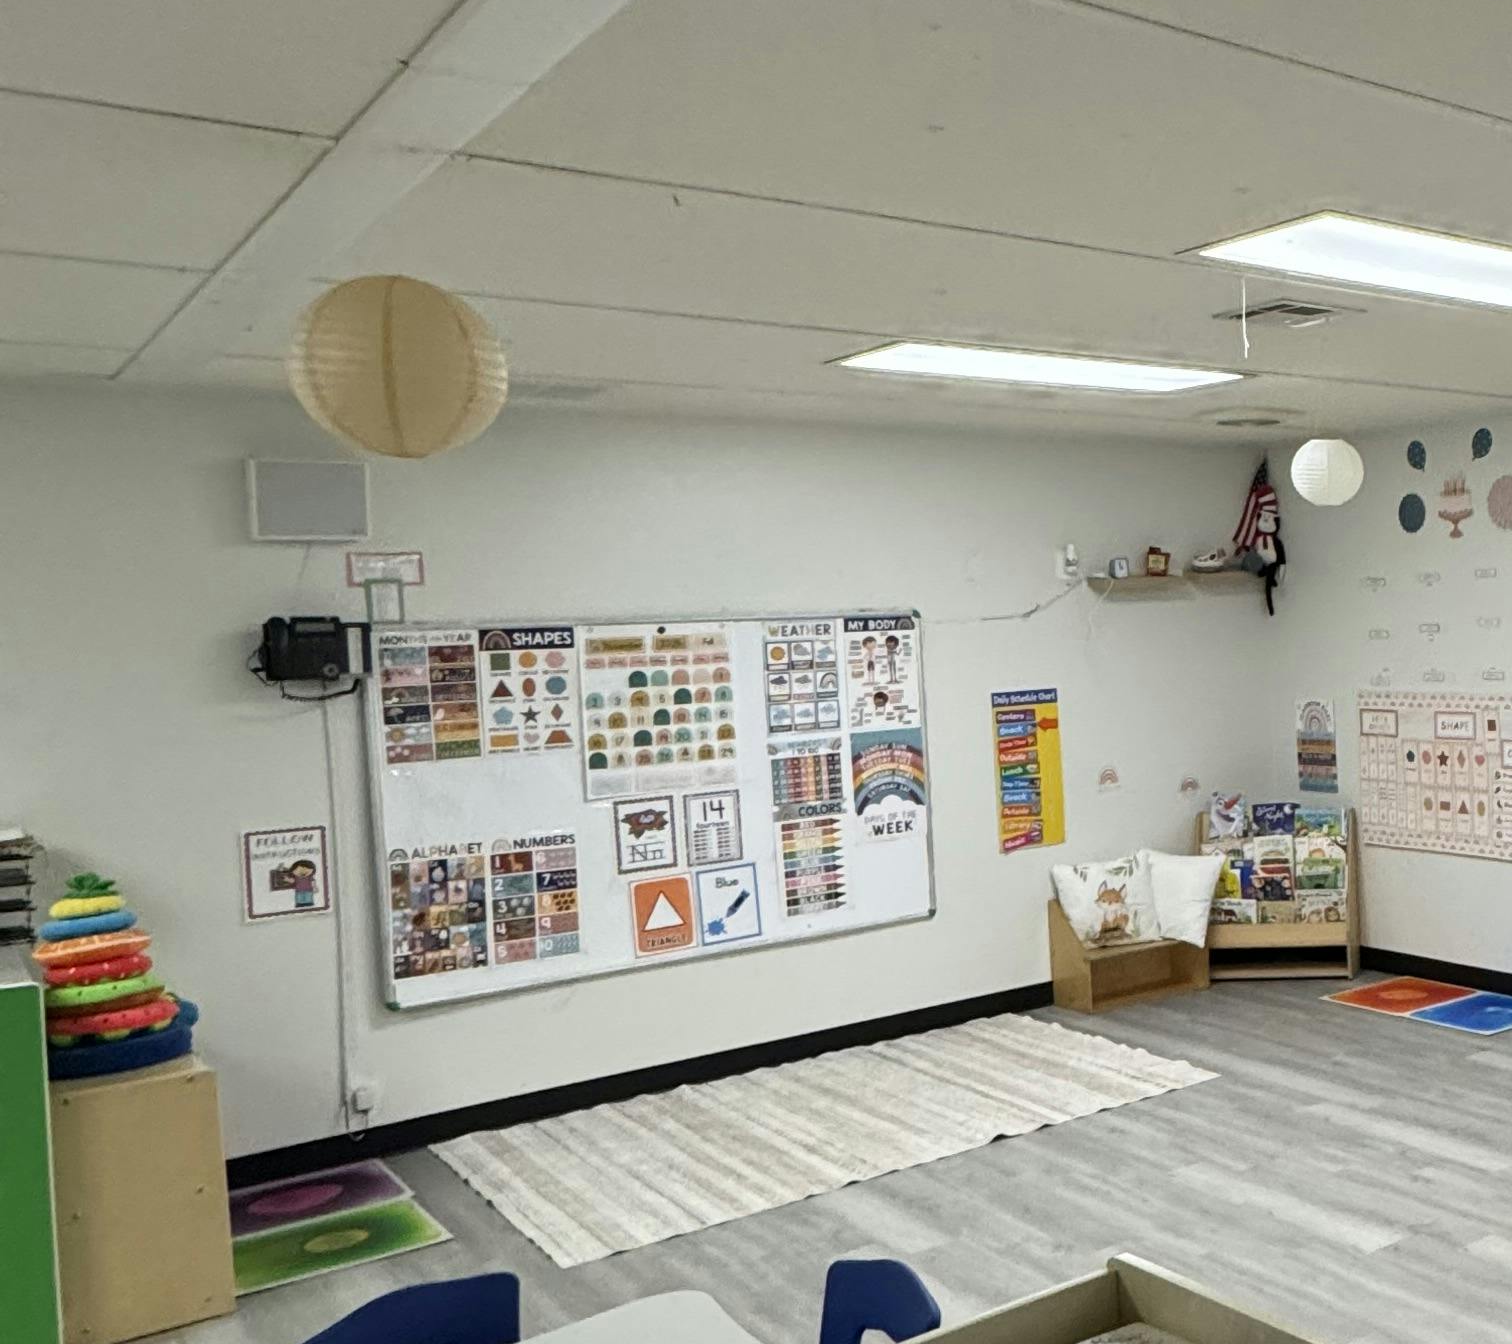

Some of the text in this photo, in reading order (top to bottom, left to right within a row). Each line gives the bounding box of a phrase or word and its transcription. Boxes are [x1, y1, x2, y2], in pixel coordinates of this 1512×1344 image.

[768, 624, 831, 636] WEATHER
[847, 619, 896, 630] MY BODY
[512, 631, 572, 646] SHAPES
[1038, 691, 1056, 701] Chart
[1441, 721, 1470, 731] SHAPE
[702, 799, 726, 822] 14
[798, 802, 842, 817] COLORS
[872, 820, 914, 836] WEEK
[513, 834, 576, 850] NUMBERS
[631, 843, 664, 863] Nn
[494, 878, 504, 891] 2
[542, 873, 552, 886] 7
[715, 876, 740, 889] Blue
[498, 901, 508, 913] 3
[495, 923, 506, 935] 4
[541, 917, 552, 929] 9
[540, 939, 554, 951] 10
